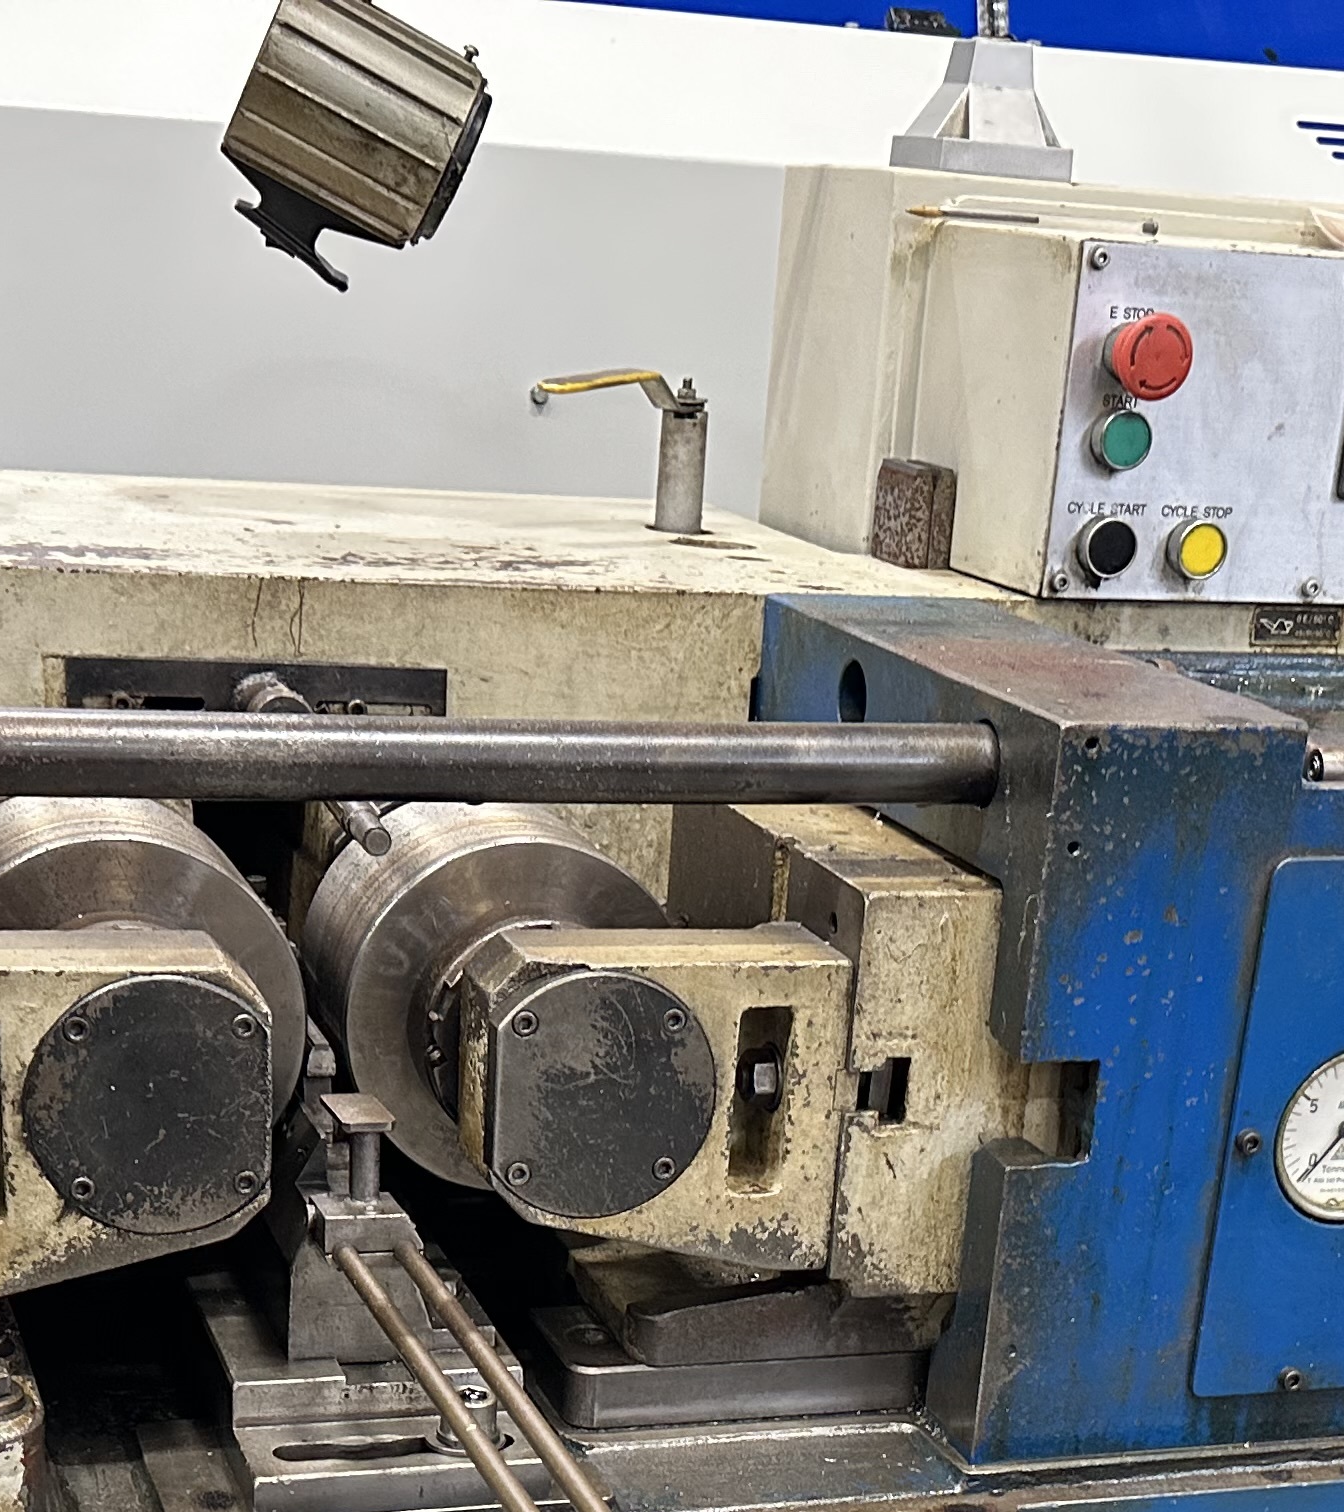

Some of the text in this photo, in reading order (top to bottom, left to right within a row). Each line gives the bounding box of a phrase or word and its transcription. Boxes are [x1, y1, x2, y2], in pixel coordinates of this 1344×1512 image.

[1109, 306, 1119, 319] E
[1102, 393, 1138, 409] START
[1110, 502, 1147, 516] START
[1161, 504, 1233, 519] CYCLE STOP
[1309, 1098, 1319, 1114] 5
[1308, 1152, 1318, 1168] 0
